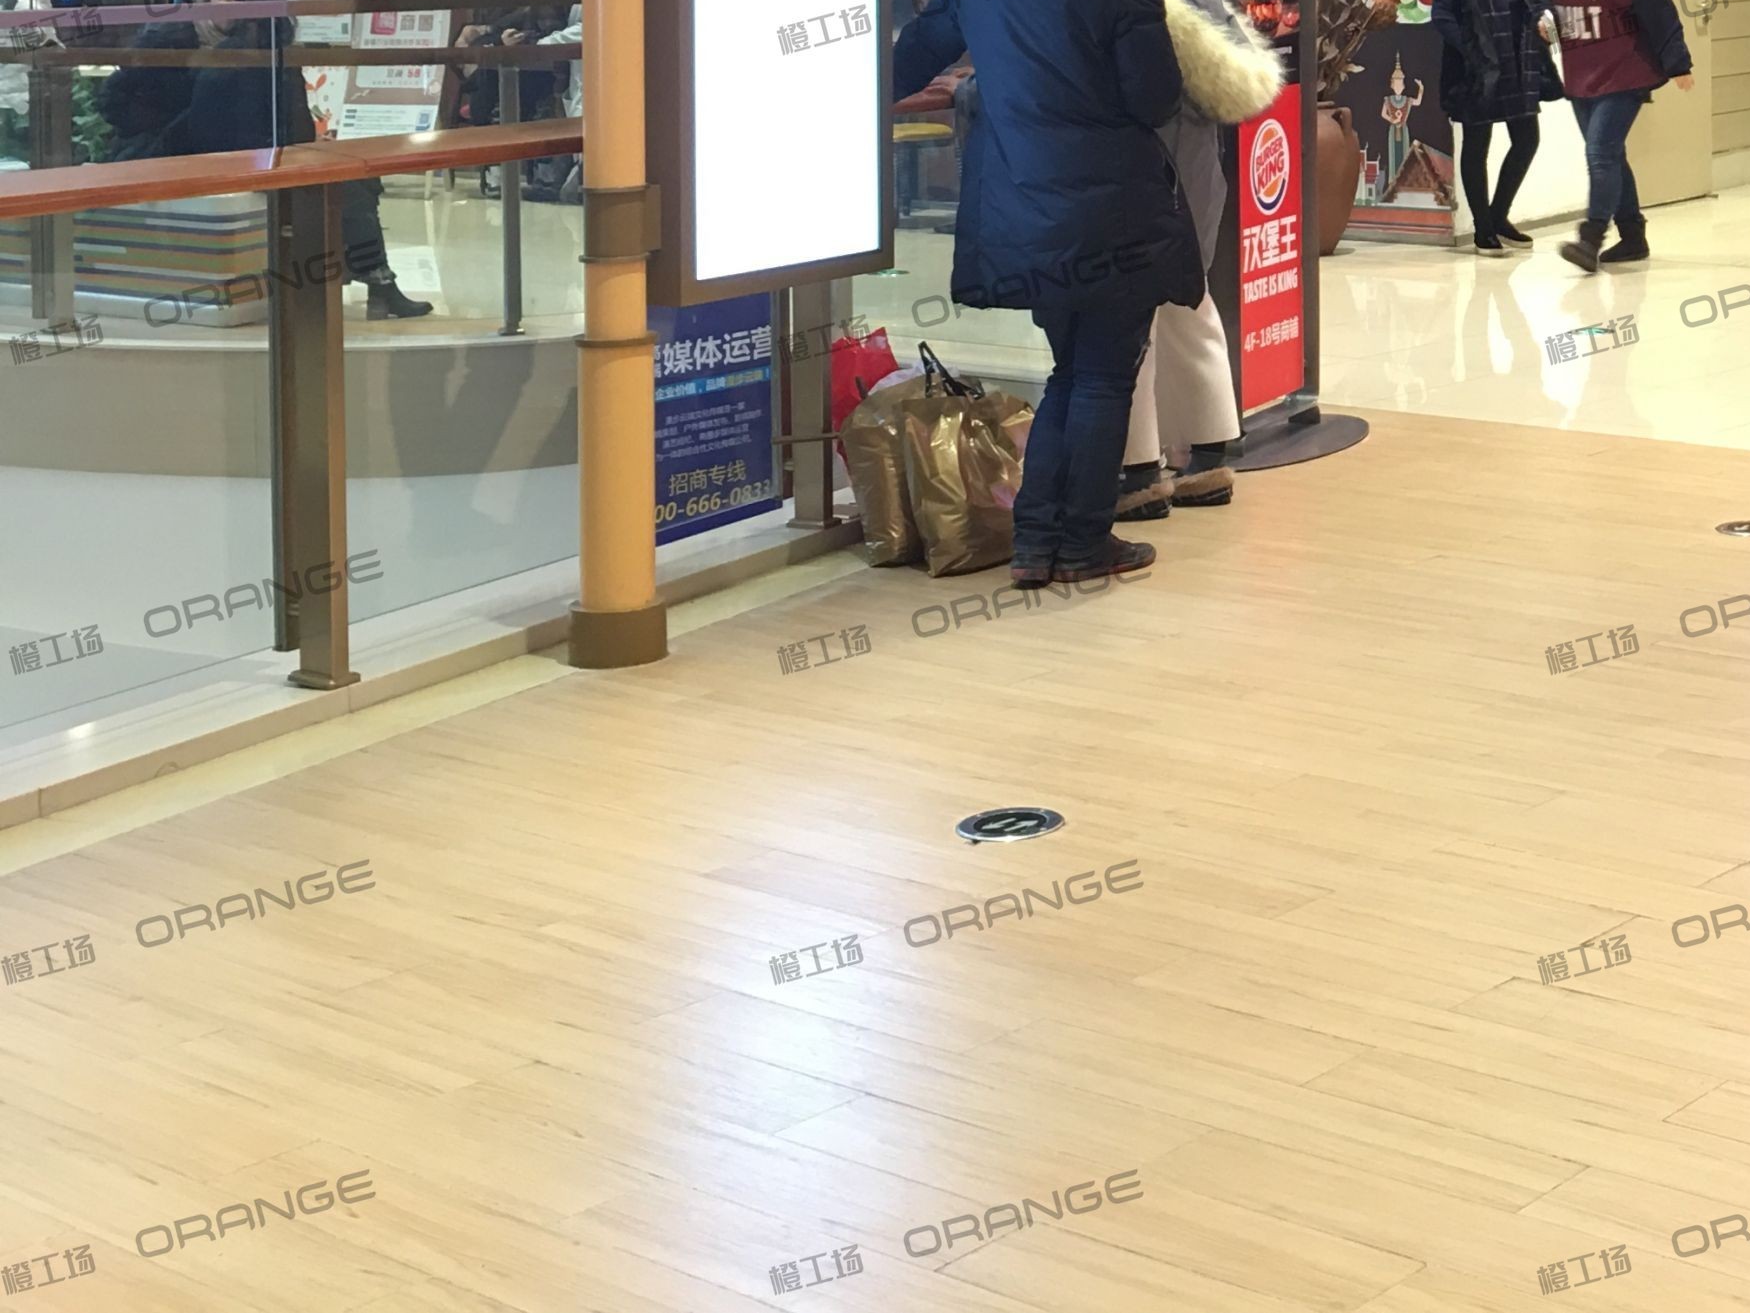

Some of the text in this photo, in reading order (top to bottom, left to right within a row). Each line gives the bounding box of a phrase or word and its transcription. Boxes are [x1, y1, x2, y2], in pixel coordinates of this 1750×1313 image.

[1256, 136, 1284, 174] BURGER
[1257, 150, 1285, 195] KING
[1243, 215, 1298, 274] 汉堡王
[1243, 267, 1298, 304] TASTE IS KING
[662, 325, 772, 376] 媒体运营
[1243, 315, 1299, 353] 4F-18号商铺
[669, 459, 746, 497] 招商专线
